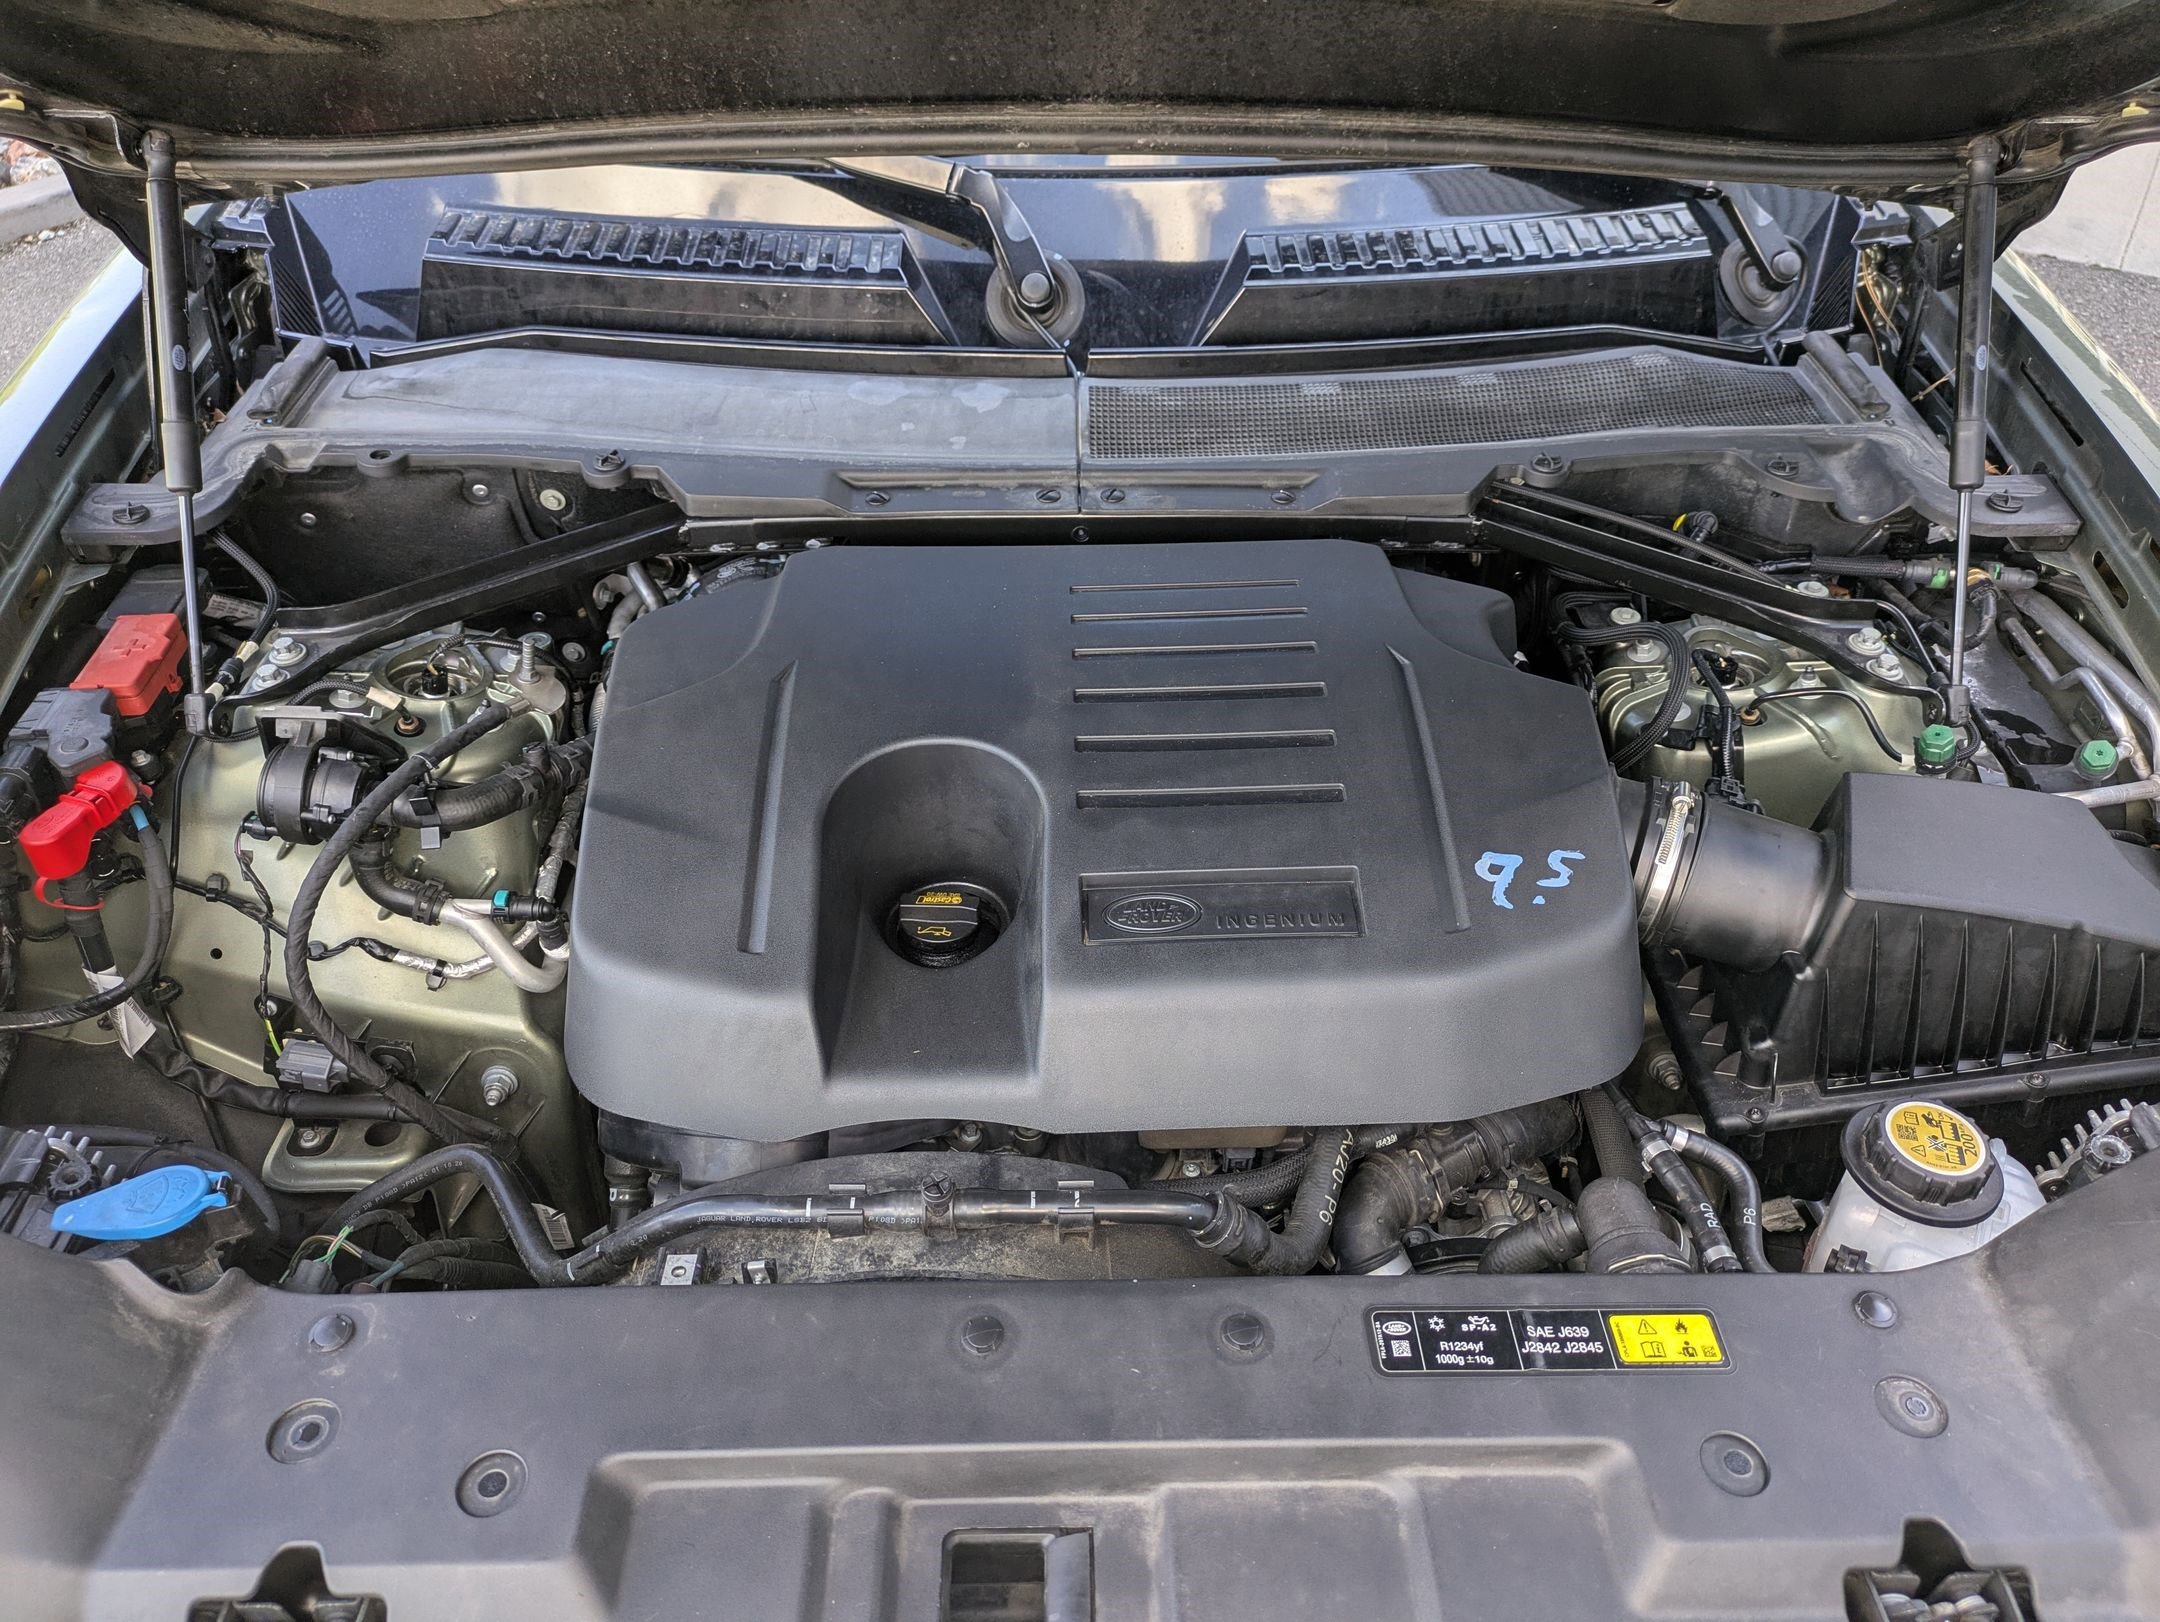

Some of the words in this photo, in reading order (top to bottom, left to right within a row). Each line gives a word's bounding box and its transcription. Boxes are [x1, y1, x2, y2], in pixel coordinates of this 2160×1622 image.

[1216, 912, 1346, 929] INGENIUM
[1960, 1133, 1978, 1158] 200
[696, 1215, 726, 1224] JAGUAR
[1700, 1203, 1721, 1229] RAD
[1743, 1207, 1757, 1226] P6
[1461, 1323, 1498, 1332] SP-A2
[1526, 1325, 1555, 1338] SAE
[1557, 1326, 1590, 1338] J639
[1439, 1341, 1485, 1353] R1234yf
[1521, 1341, 1562, 1354] J2842
[1564, 1341, 1604, 1354] J2845
[1435, 1354, 1466, 1366] 1000g
